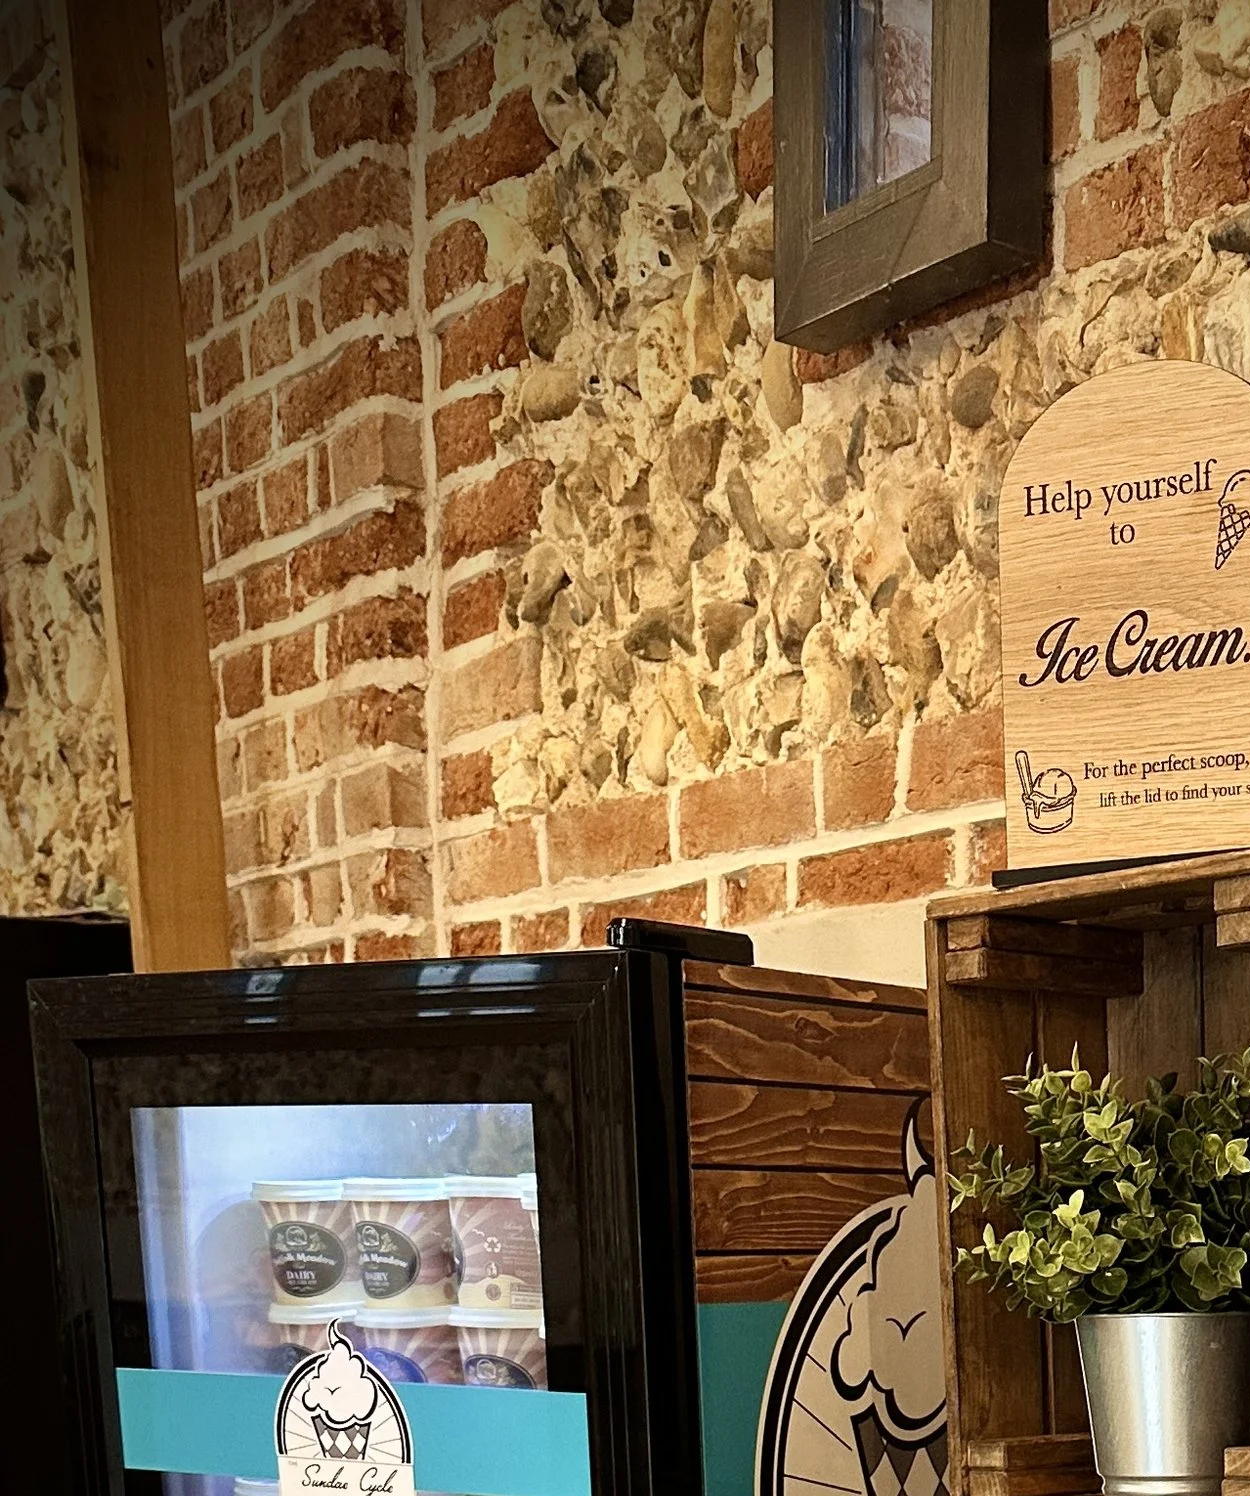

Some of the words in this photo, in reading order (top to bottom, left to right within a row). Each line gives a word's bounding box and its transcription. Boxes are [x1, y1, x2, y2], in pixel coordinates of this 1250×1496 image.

[1023, 481, 1093, 520] Help
[1100, 458, 1218, 516] yourself
[1109, 520, 1136, 546] to
[1018, 616, 1100, 689] Ice
[1083, 761, 1109, 780] For
[1112, 759, 1138, 778] the
[1141, 754, 1195, 780] perfect
[1200, 751, 1250, 774] scoop,
[1099, 789, 1118, 808] lift
[1120, 788, 1141, 806] the
[1144, 787, 1162, 803] lid
[1165, 788, 1179, 801] to
[1182, 784, 1209, 800] find
[1211, 784, 1242, 801] your
